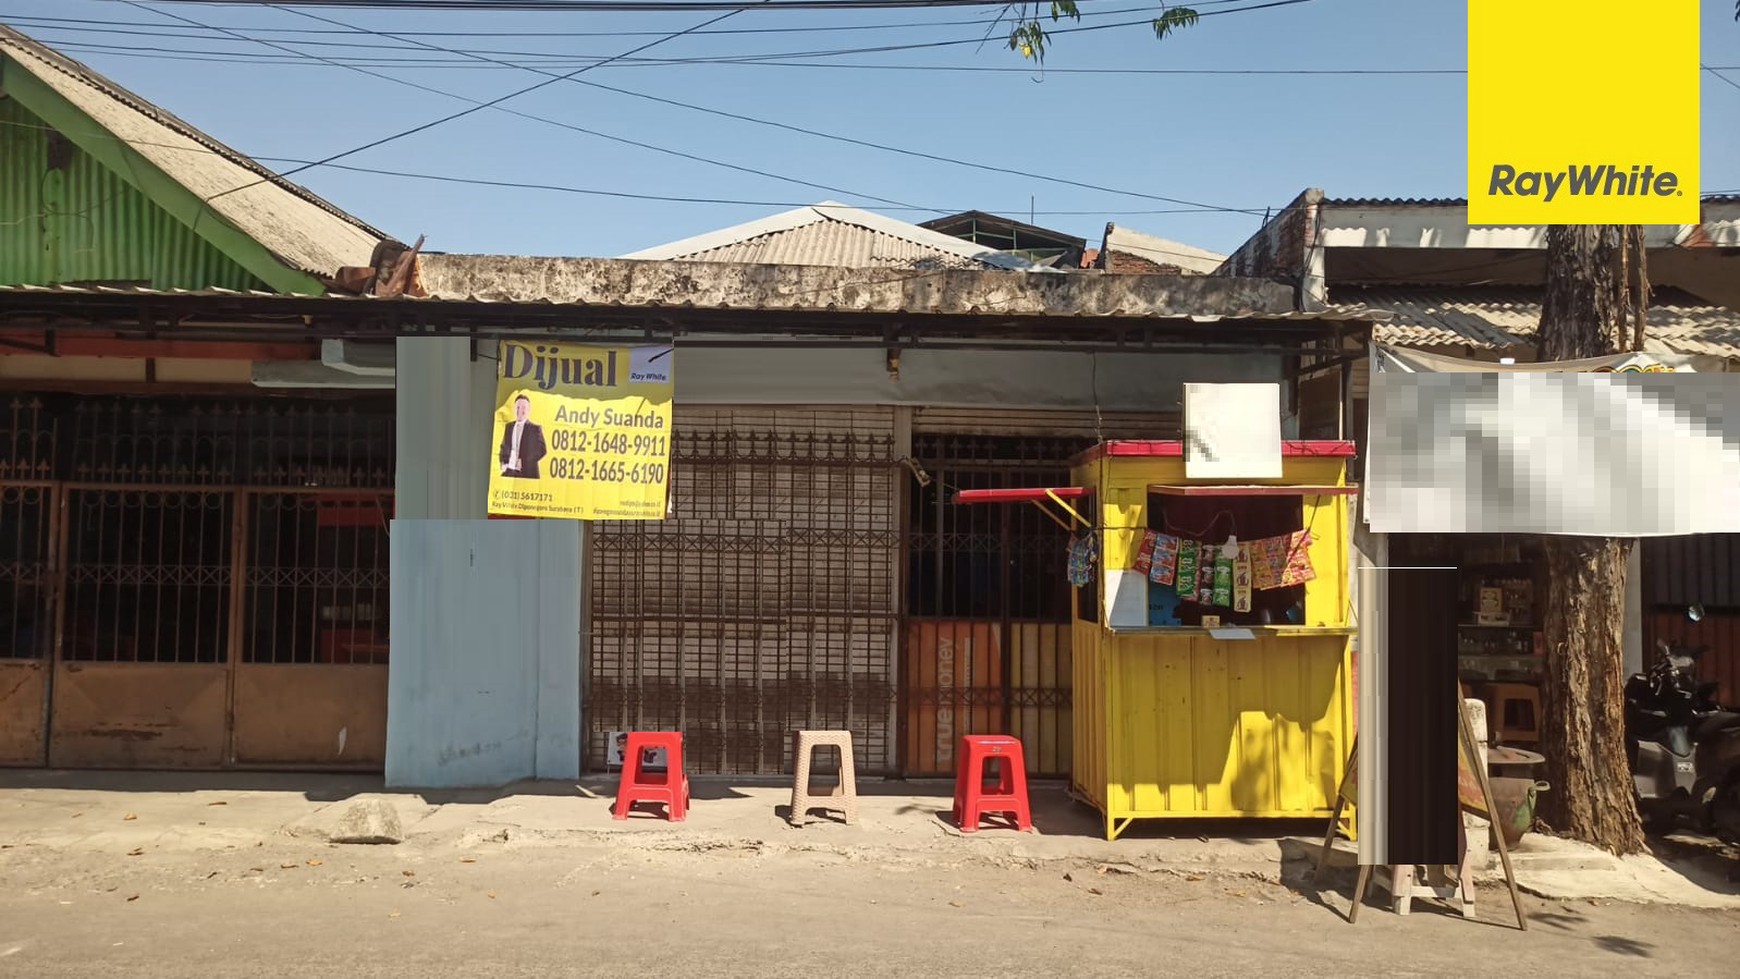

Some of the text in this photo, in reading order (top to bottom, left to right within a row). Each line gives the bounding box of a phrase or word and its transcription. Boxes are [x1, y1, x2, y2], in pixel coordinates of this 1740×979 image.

[503, 344, 617, 390] Dijual
[631, 372, 666, 381] Ray White
[554, 405, 664, 429] Andy Suanda
[551, 429, 665, 457] 0812-1648-9911
[549, 457, 664, 484] 0812-1665-6190
[521, 492, 553, 502] 5617171
